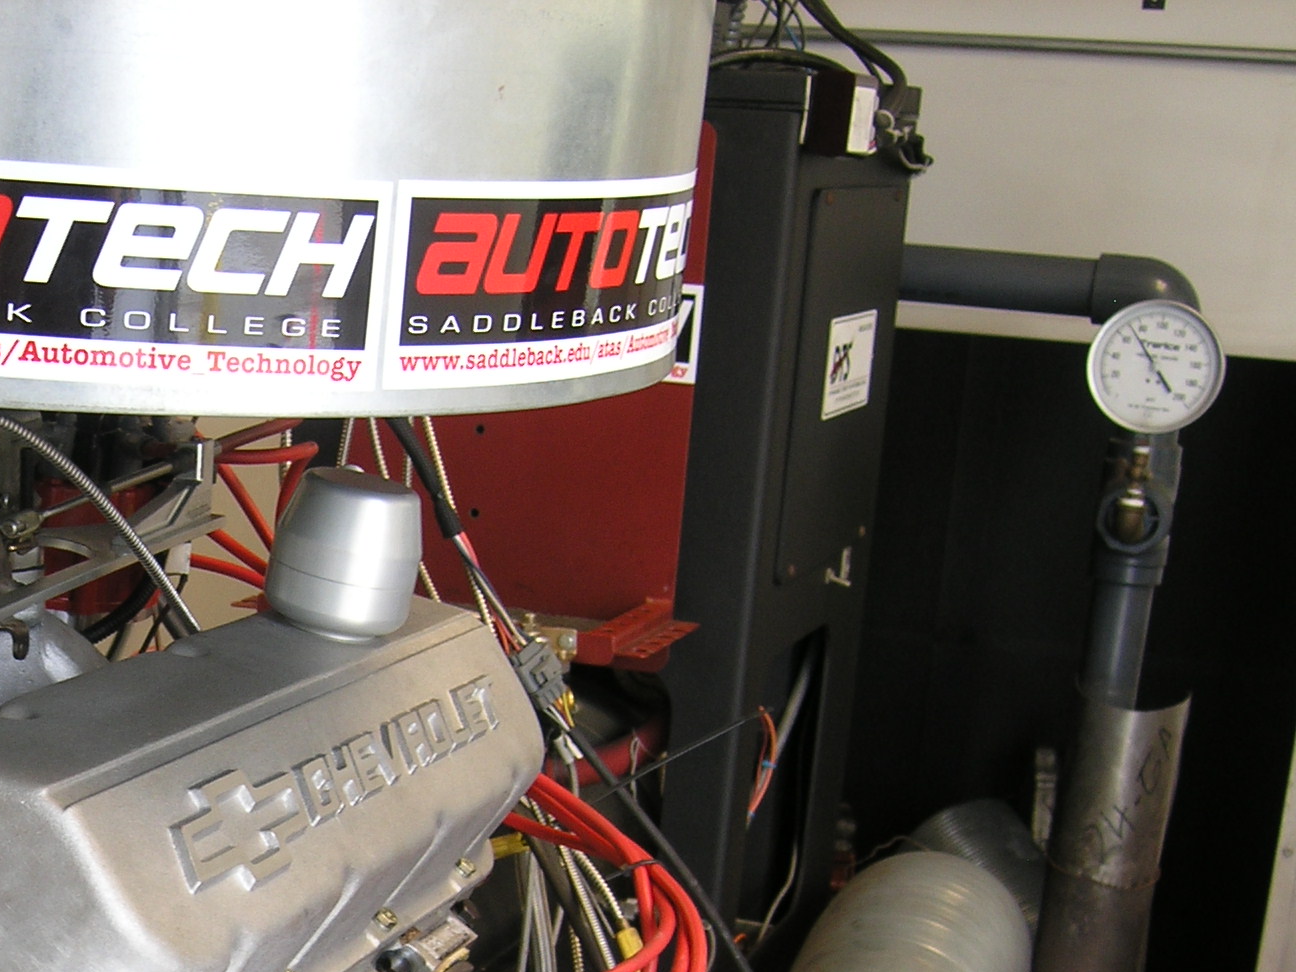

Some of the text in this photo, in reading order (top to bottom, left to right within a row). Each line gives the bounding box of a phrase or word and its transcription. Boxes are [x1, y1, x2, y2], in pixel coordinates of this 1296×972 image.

[79, 307, 343, 339] COLLEGE
[407, 302, 638, 335] SADDLEBACK
[290, 673, 500, 828] CHEVROLET
